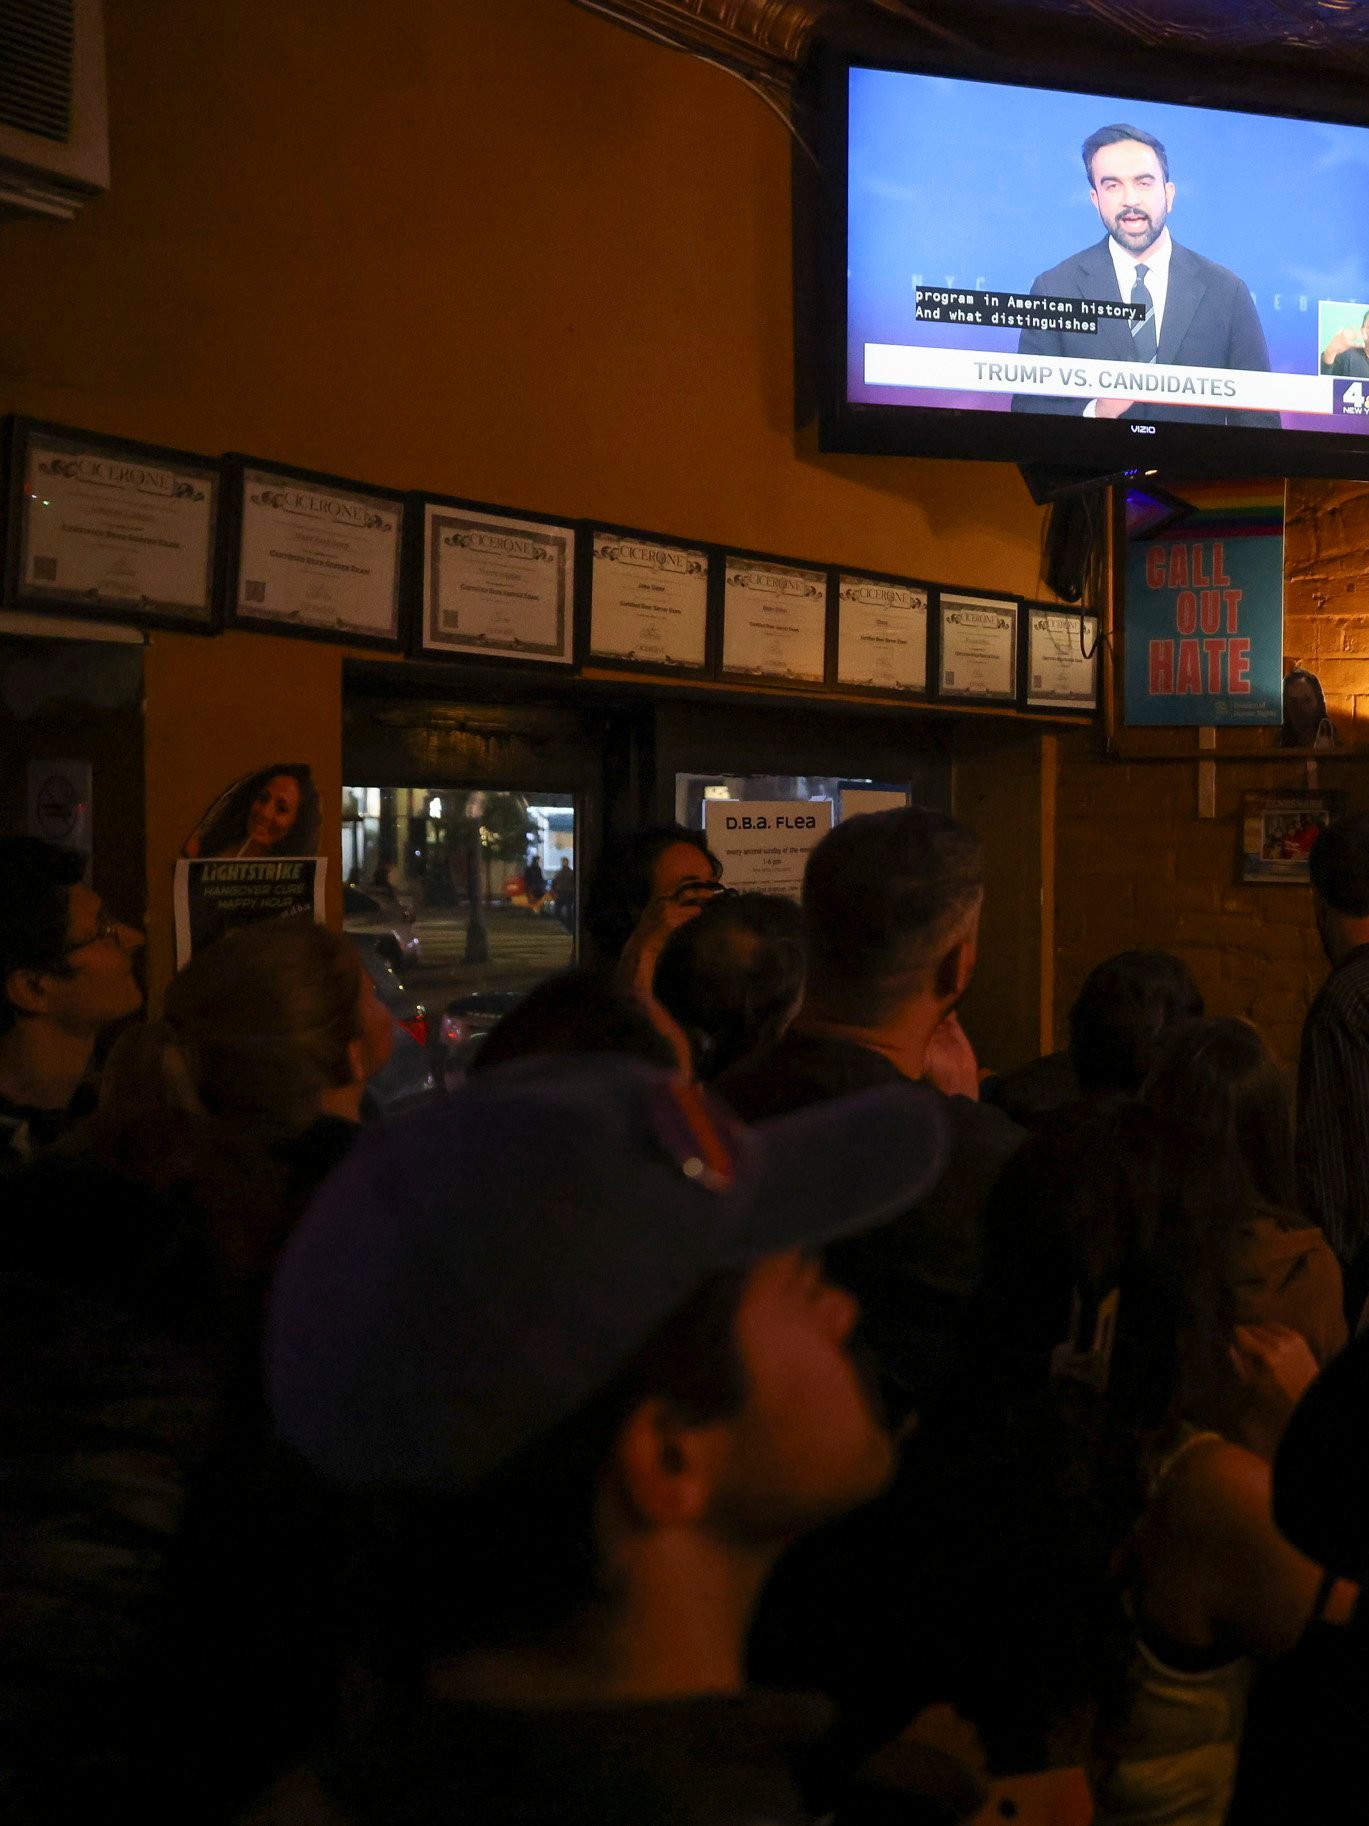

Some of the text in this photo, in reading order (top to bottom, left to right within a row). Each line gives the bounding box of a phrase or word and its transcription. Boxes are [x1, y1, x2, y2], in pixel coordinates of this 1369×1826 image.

[915, 289, 1144, 319] program in American history.
[915, 306, 1096, 331] And what distinguishes
[973, 361, 1237, 397] TRUMP VS. CANDIDATES
[1342, 382, 1364, 408] 4
[1343, 407, 1363, 416] NEW
[1130, 425, 1156, 434] VIZIO
[1145, 543, 1230, 589] CALL
[1176, 589, 1243, 635] OUT
[1147, 637, 1251, 695] HATE
